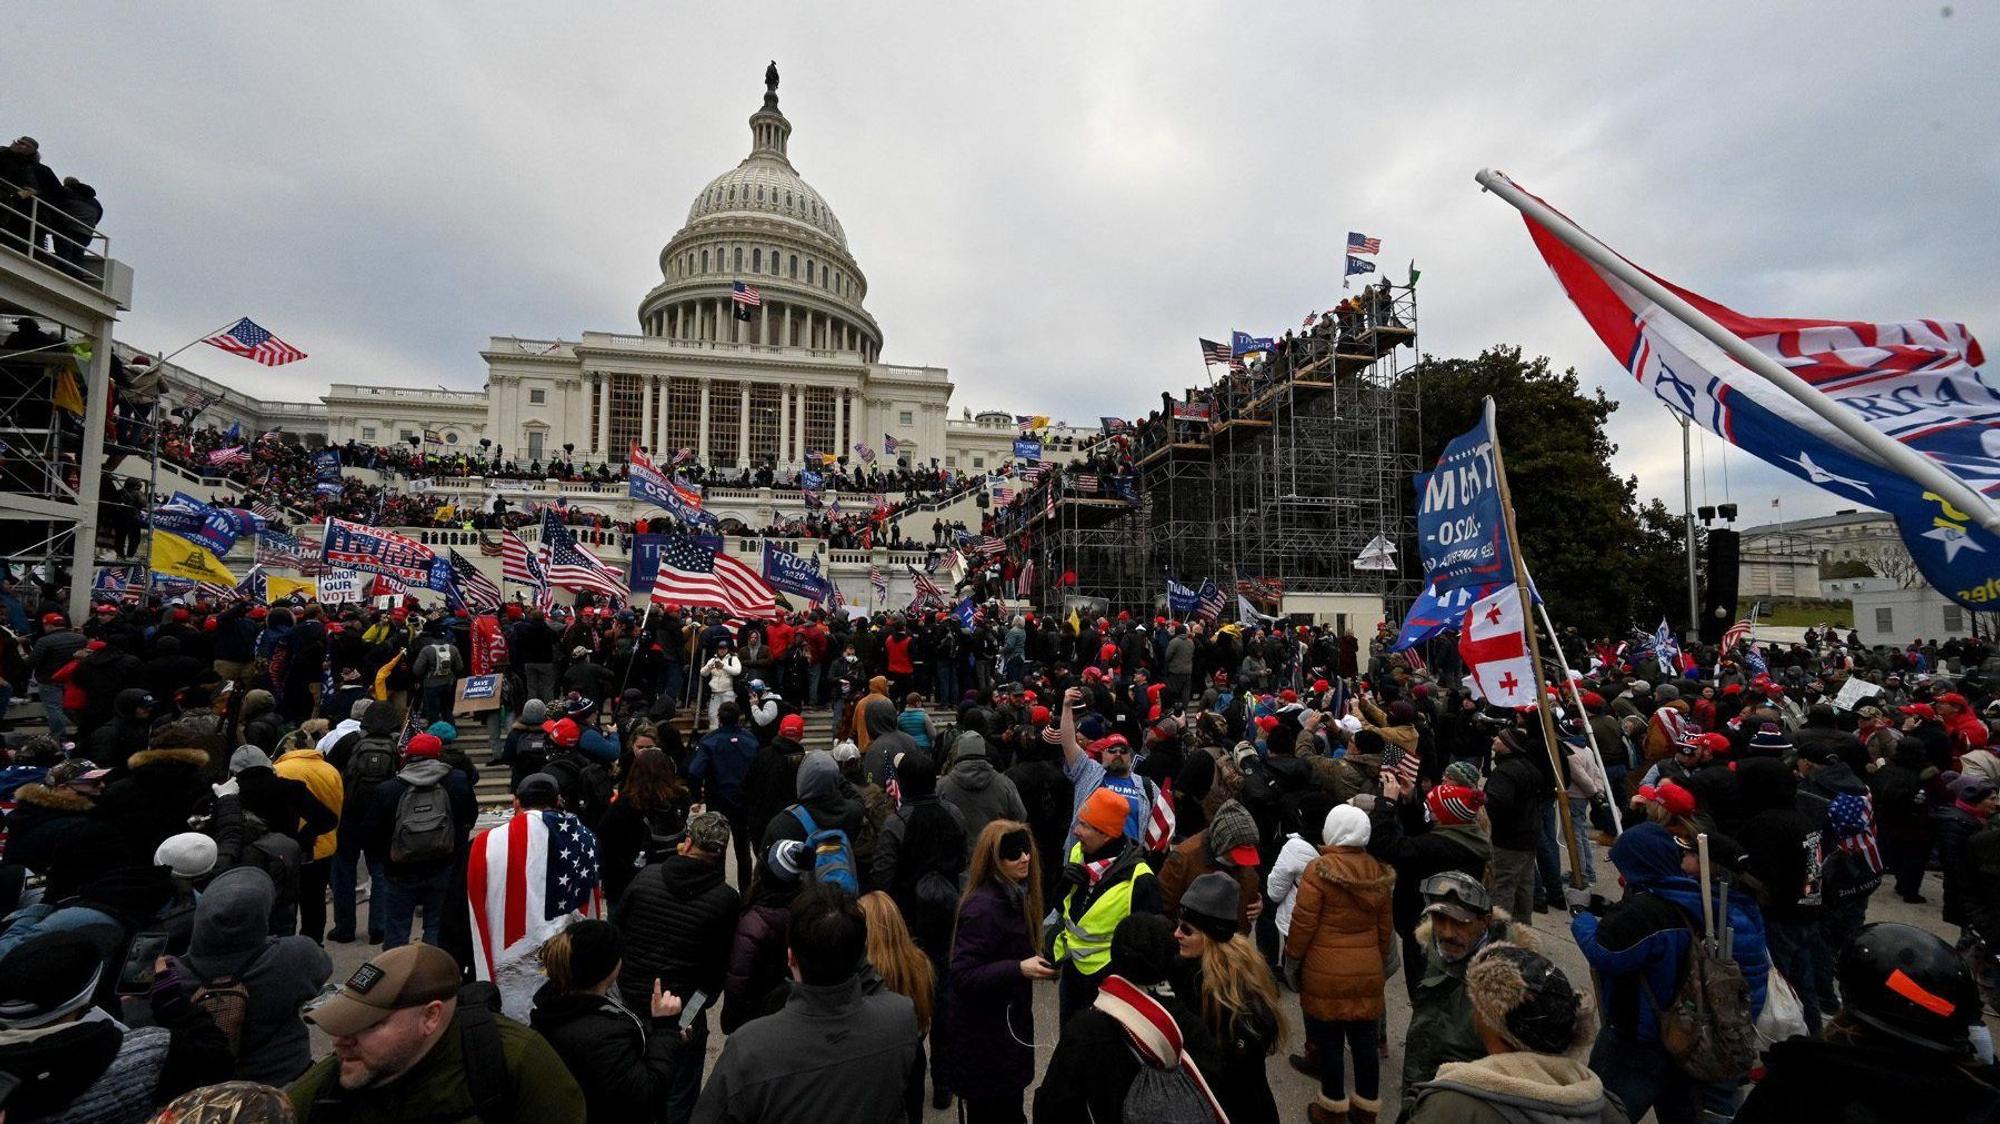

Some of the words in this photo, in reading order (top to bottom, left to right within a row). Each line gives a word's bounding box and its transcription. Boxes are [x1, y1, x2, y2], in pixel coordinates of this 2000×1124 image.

[332, 525, 421, 568] TRUMP
[319, 570, 357, 581] HONOR
[324, 581, 352, 591] OUR
[322, 591, 356, 601] VOTE
[1108, 784, 1138, 796] RUMP
